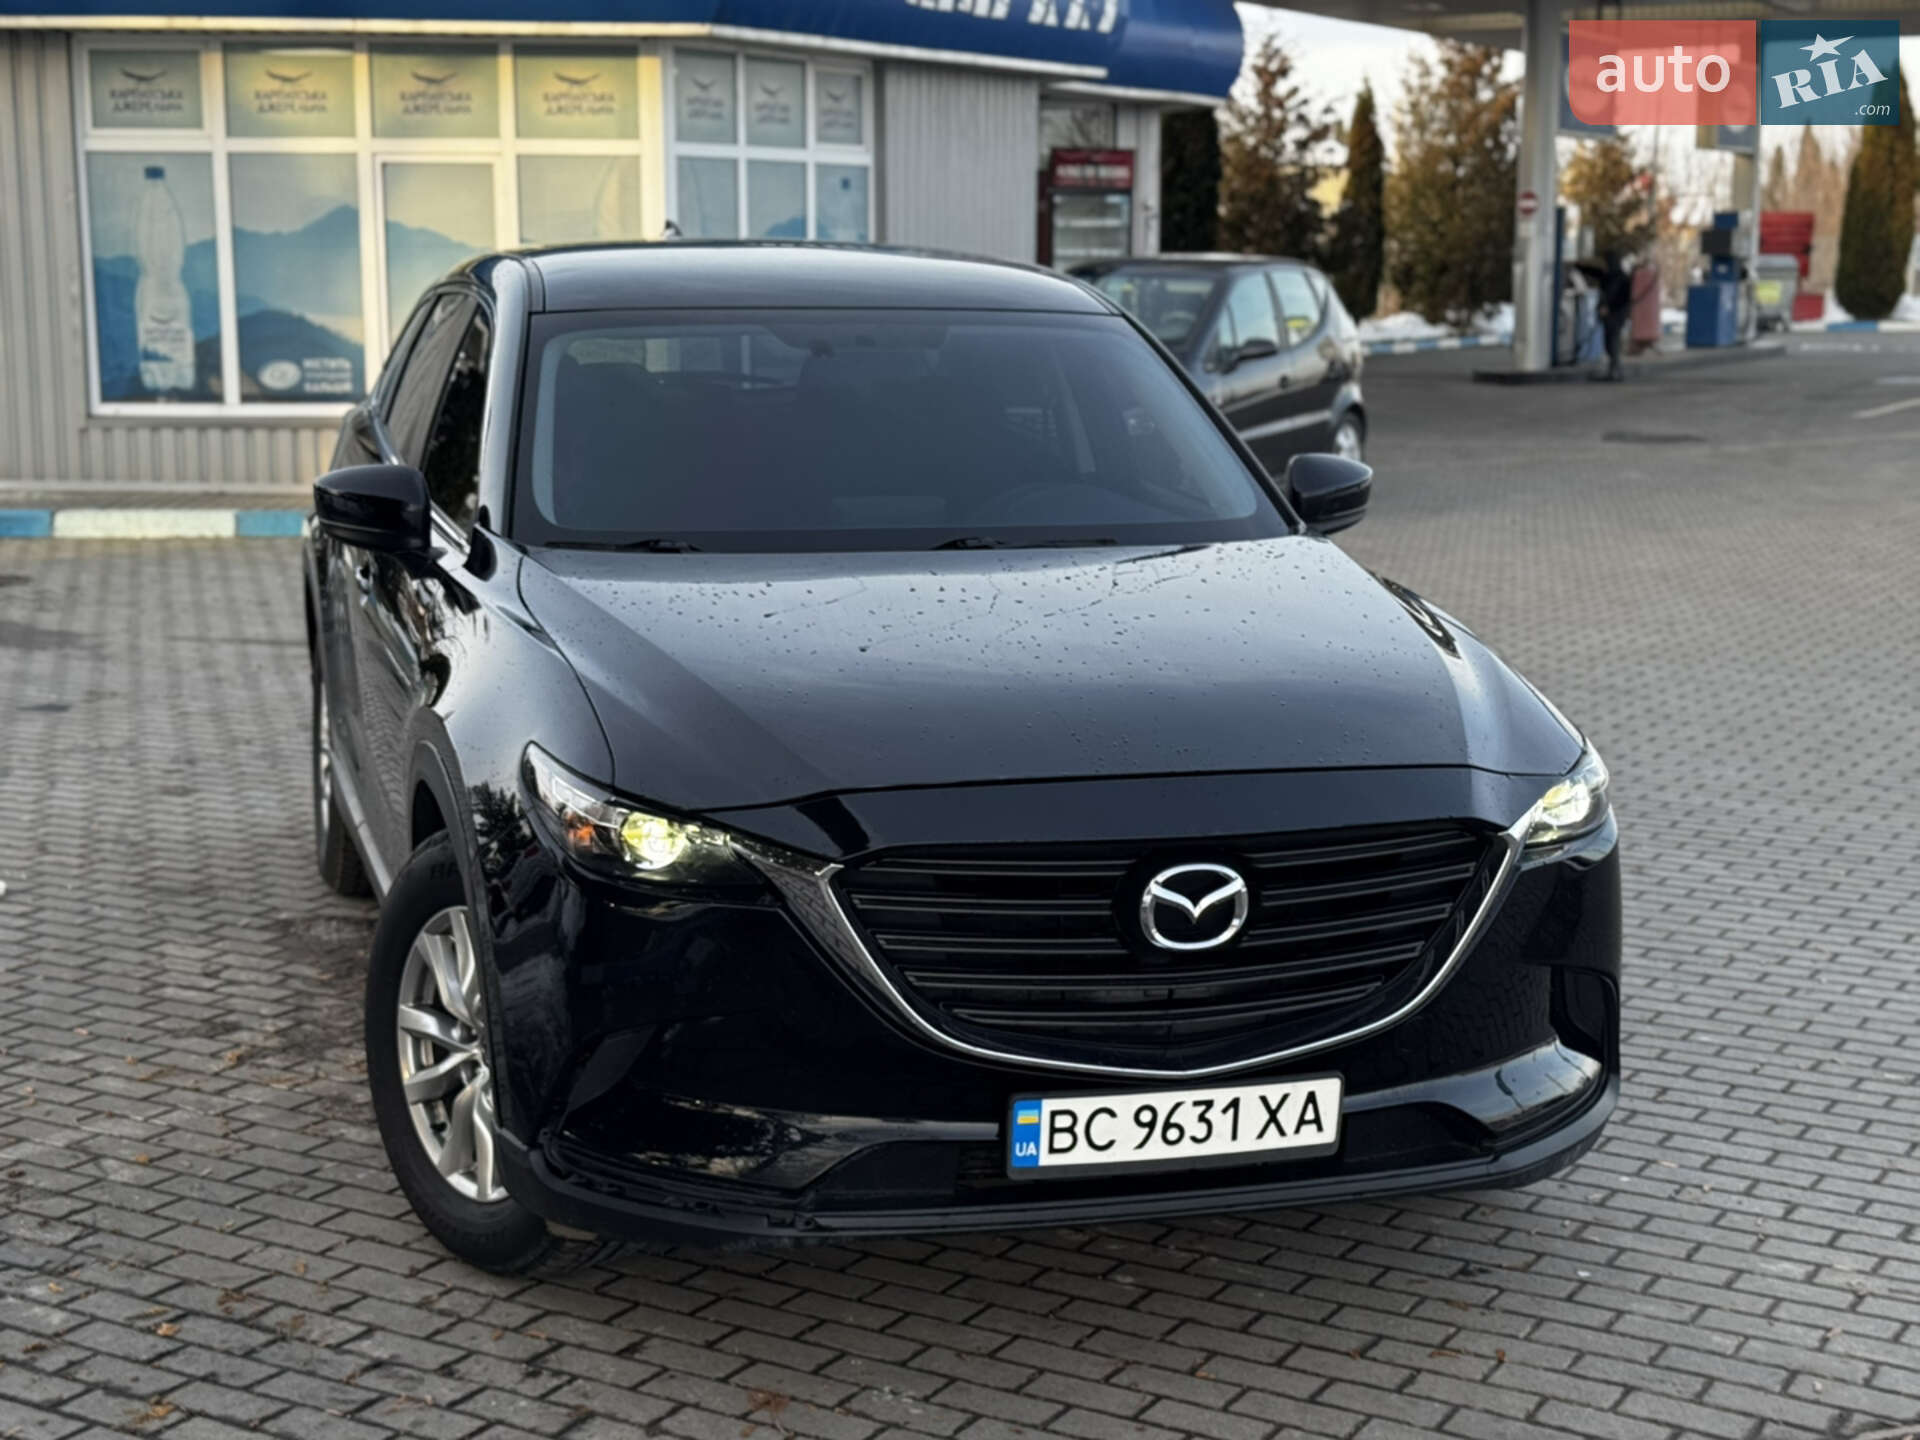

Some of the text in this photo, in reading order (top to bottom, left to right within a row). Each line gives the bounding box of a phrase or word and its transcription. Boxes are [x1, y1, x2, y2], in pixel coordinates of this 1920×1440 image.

[1048, 1090, 1325, 1155] BC 9631 XA
[1015, 1143, 1037, 1157] UA
